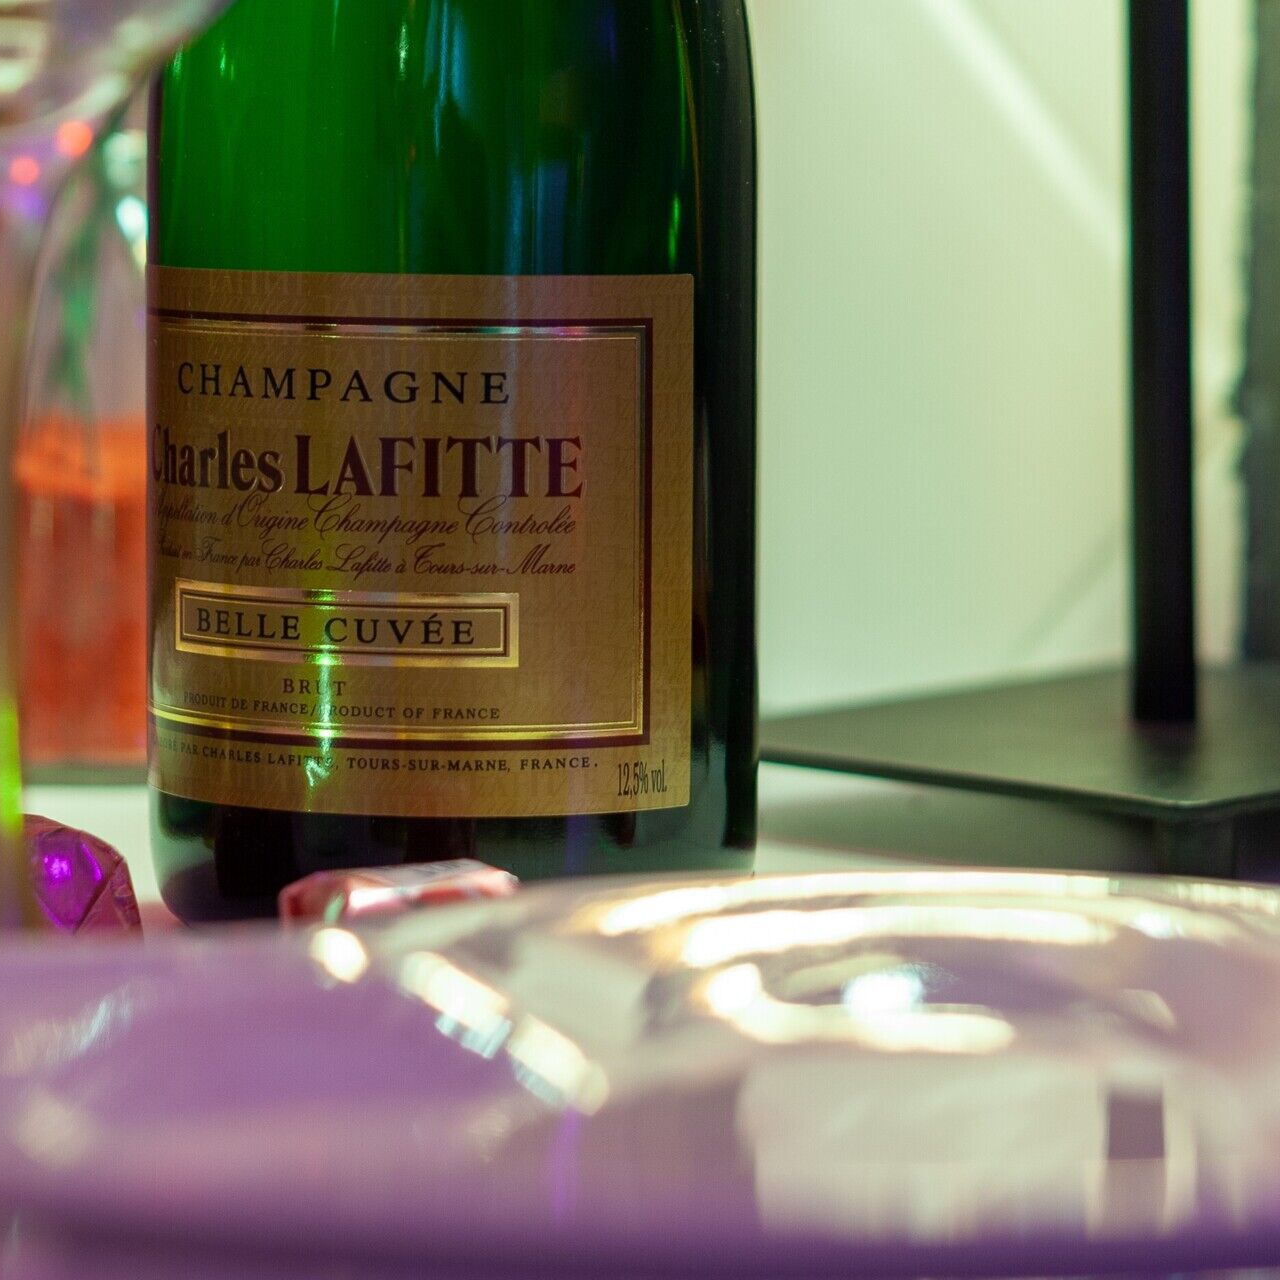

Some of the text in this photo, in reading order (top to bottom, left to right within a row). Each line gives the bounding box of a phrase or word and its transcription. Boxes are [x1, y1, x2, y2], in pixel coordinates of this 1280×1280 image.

[178, 362, 510, 404] CHAMPAGNE
[152, 423, 583, 498] Charles LAFITTE
[307, 493, 458, 544] Champagne
[195, 536, 237, 563] France
[235, 553, 261, 573] par
[261, 538, 323, 574] Charles
[326, 543, 391, 580] Lafitte
[394, 558, 404, 574] à
[413, 543, 576, 575] Tours-sur-Marne
[196, 607, 475, 645] BELLE CUVÉE
[183, 691, 500, 720] PRODUIT DE FRANCE/RODUCT OF FRANCE
[180, 743, 199, 755] PAR
[202, 747, 261, 763] CHARLES
[346, 757, 511, 773] TOURS-SUR-MARNE,
[520, 756, 598, 771] FRANCE.
[617, 759, 668, 799] 12,5% vol.
